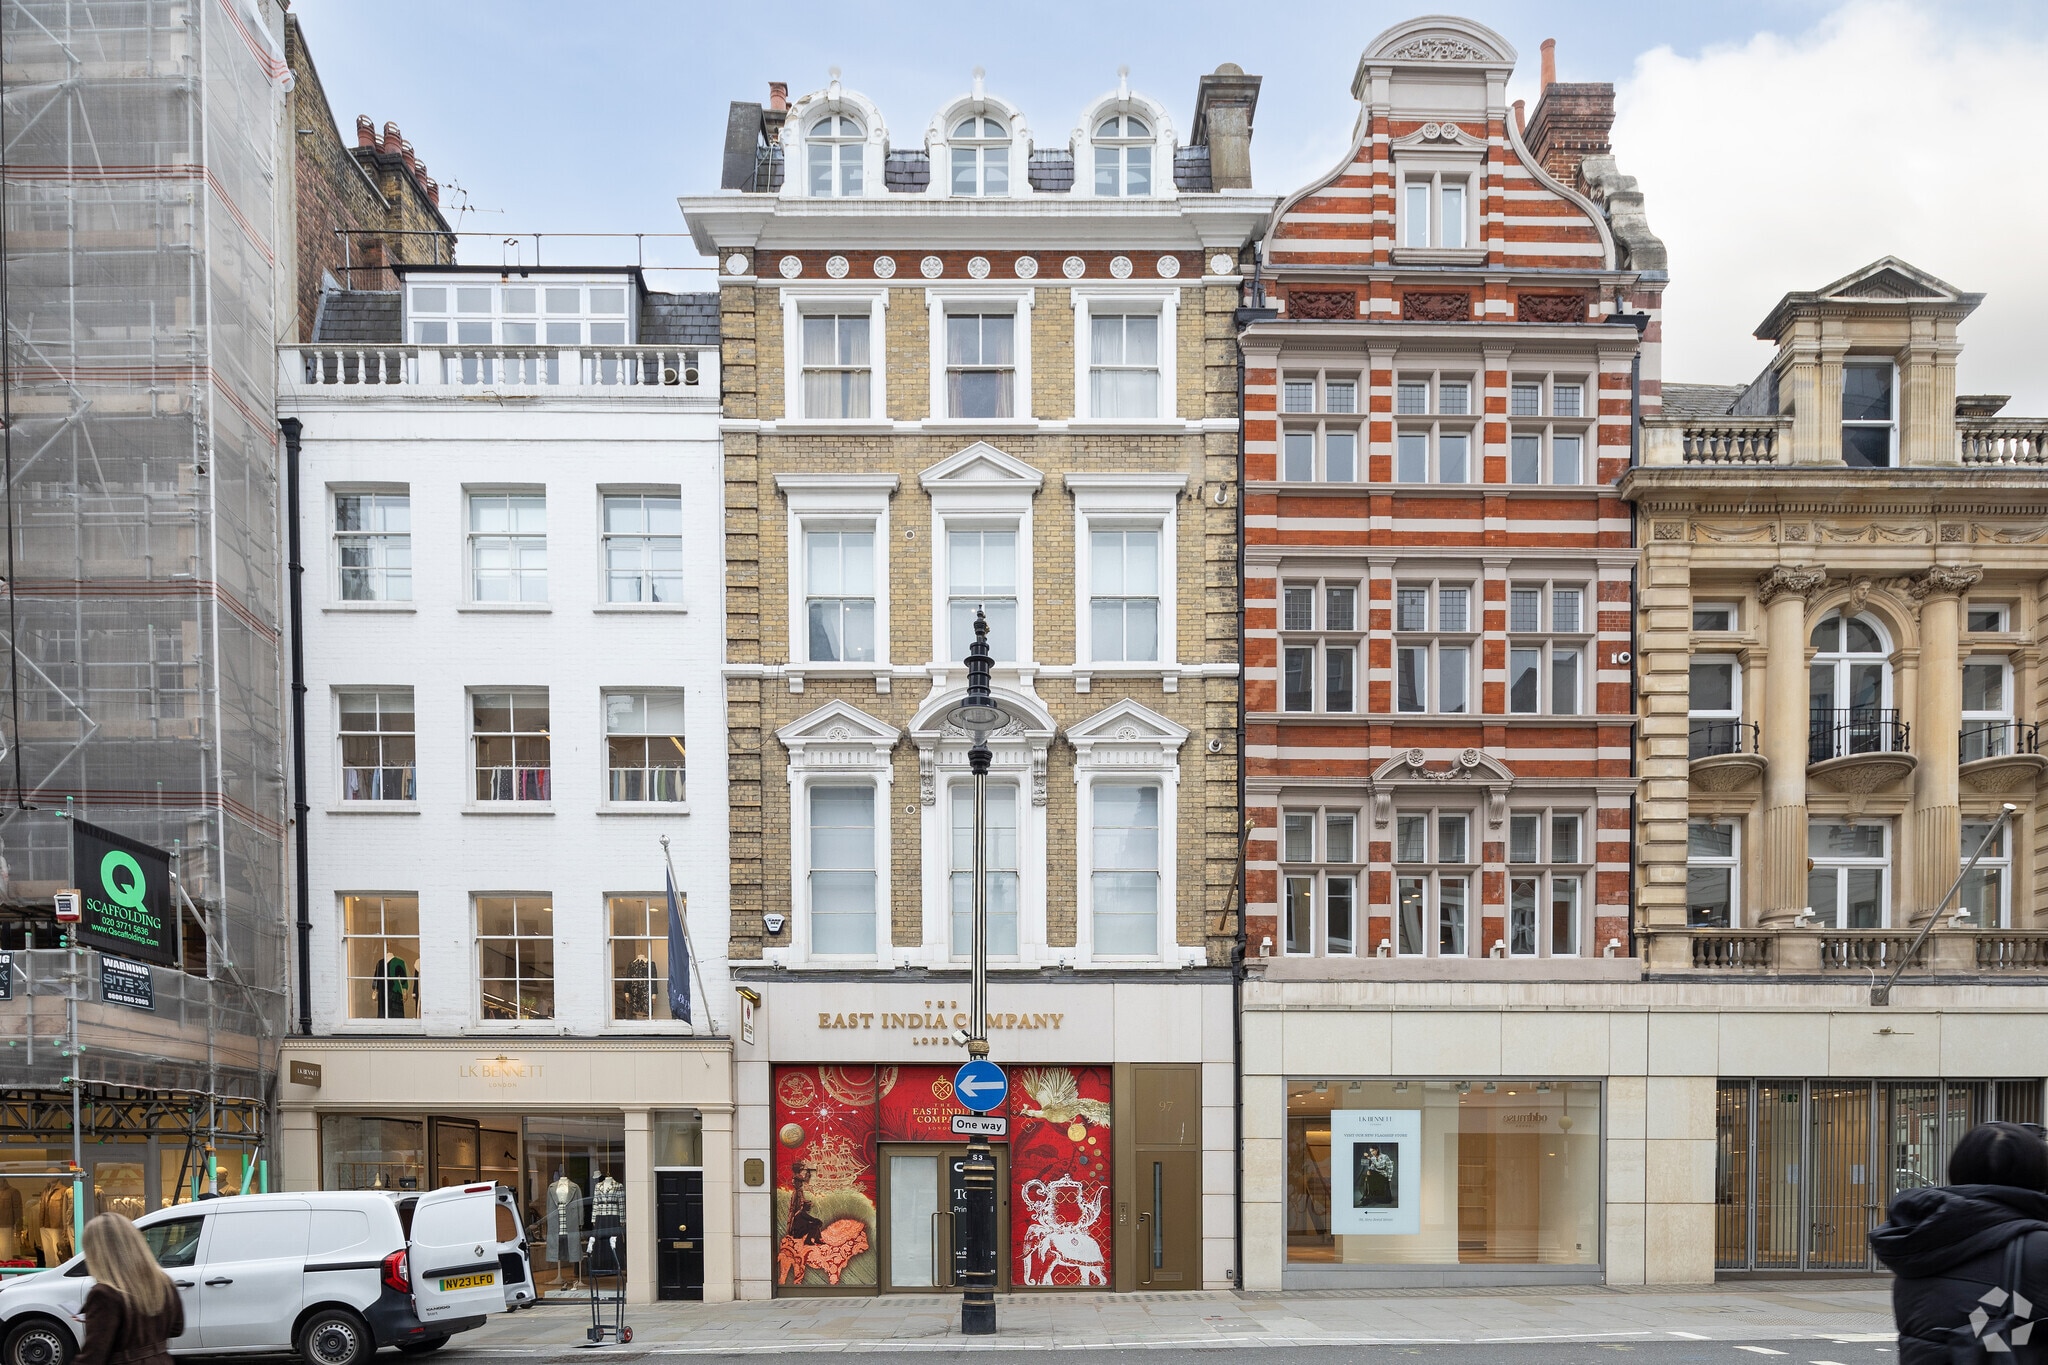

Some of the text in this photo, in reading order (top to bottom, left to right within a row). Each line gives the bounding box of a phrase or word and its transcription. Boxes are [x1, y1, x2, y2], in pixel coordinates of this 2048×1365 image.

[86, 898, 161, 929] SCAFFOLDING
[102, 916, 149, 936] 020 3771 5636
[91, 924, 159, 946] www.Qscaffolding.com
[103, 957, 149, 976] WARNING
[103, 973, 150, 992] SITE-X
[925, 1000, 958, 1009] THE
[818, 1012, 1064, 1029] EAST INDIA CMPANY
[459, 1065, 545, 1078] LK BENNETT
[1159, 1101, 1173, 1112] 97
[917, 1115, 952, 1124] COMPA
[956, 1119, 1002, 1132] One way
[446, 1274, 493, 1289] NV23 LFO
